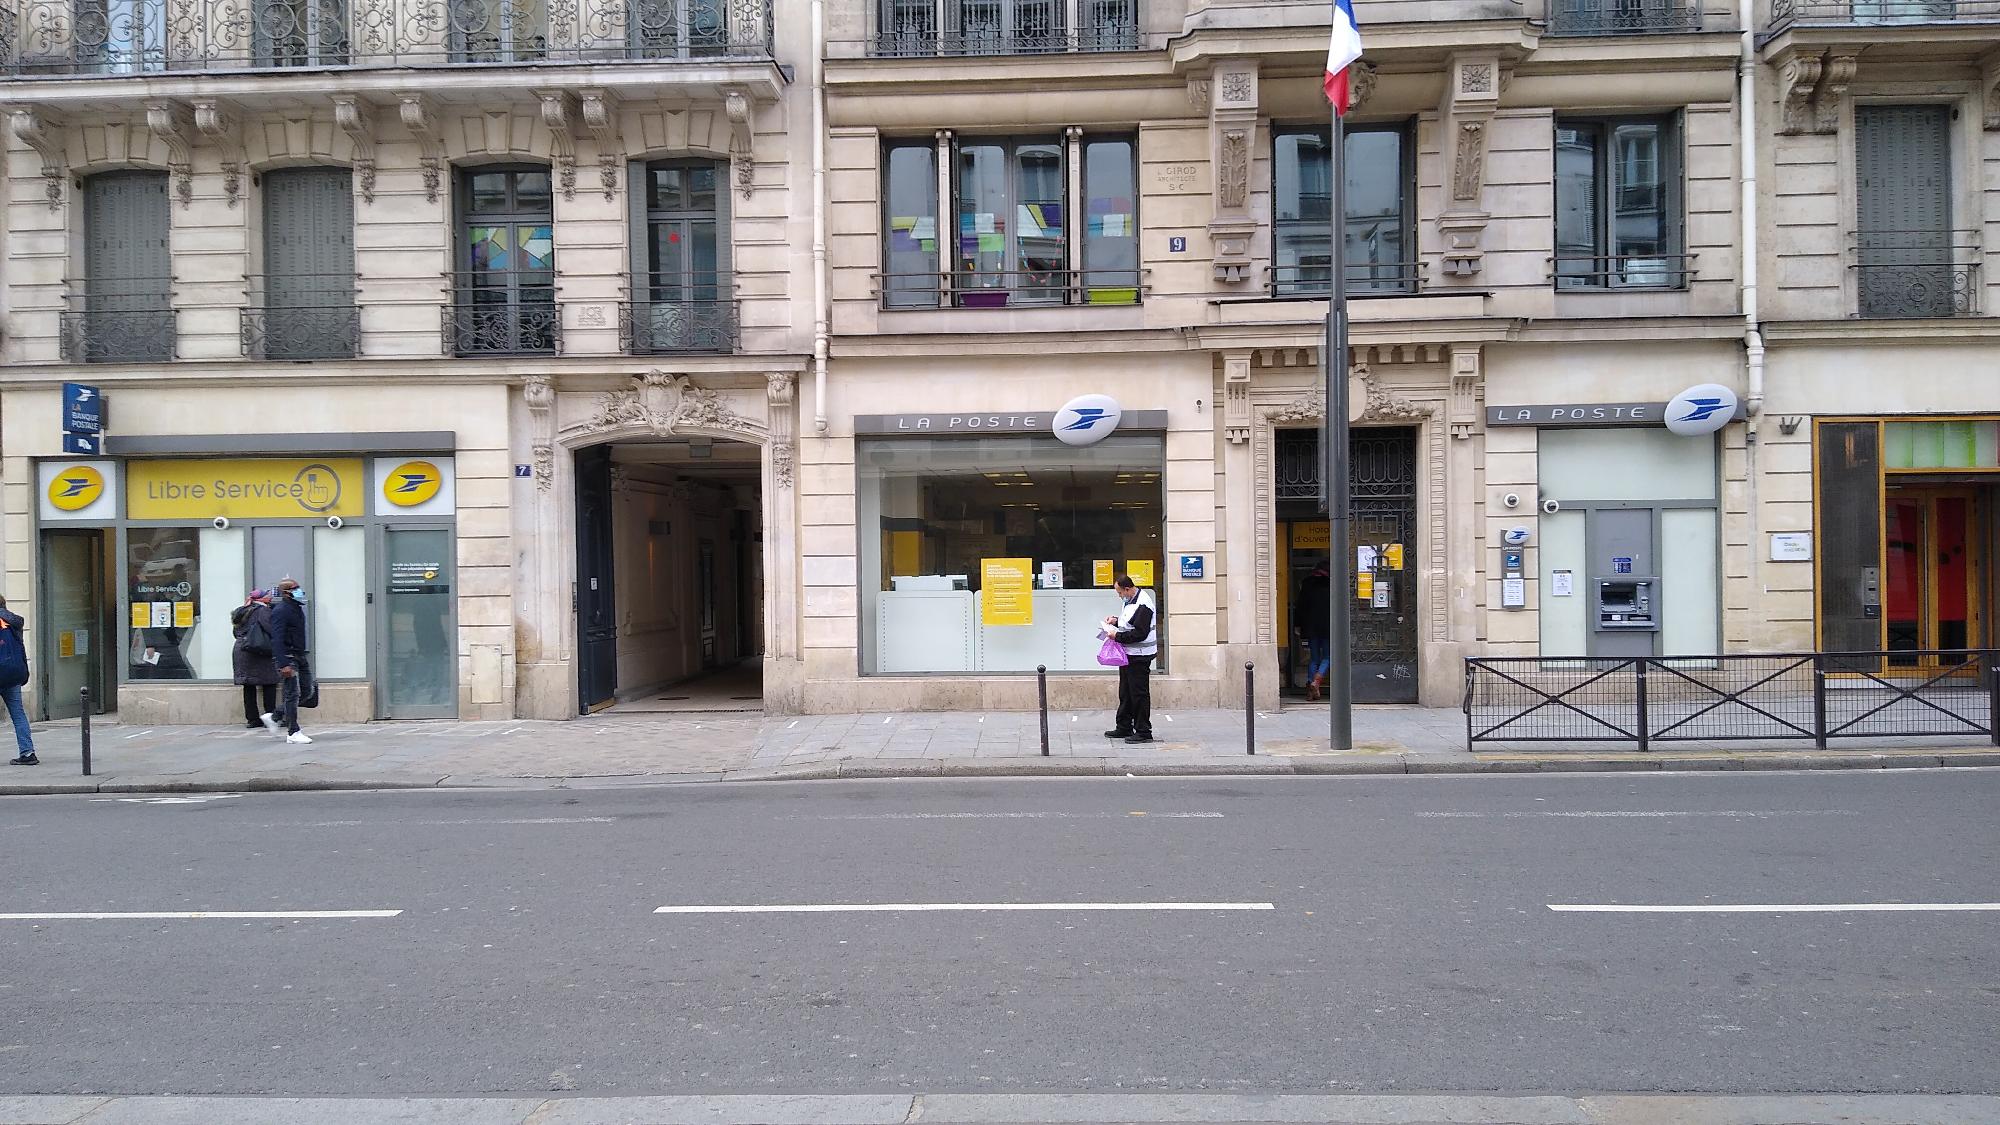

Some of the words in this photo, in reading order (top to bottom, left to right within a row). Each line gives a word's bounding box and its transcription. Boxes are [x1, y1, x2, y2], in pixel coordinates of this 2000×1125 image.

[1166, 166, 1197, 175] GIROD
[1173, 237, 1182, 251] 9
[72, 403, 81, 411] LA
[72, 411, 99, 421] BANQUE
[1498, 409, 1531, 421] LA
[1551, 407, 1645, 420] POSTE
[72, 420, 99, 430] POSTALE
[899, 417, 931, 429] LA
[949, 416, 1037, 428] POSTE
[519, 466, 527, 476] 7
[148, 479, 206, 499] Libre
[213, 479, 303, 498] Service
[137, 585, 155, 593] Libre
